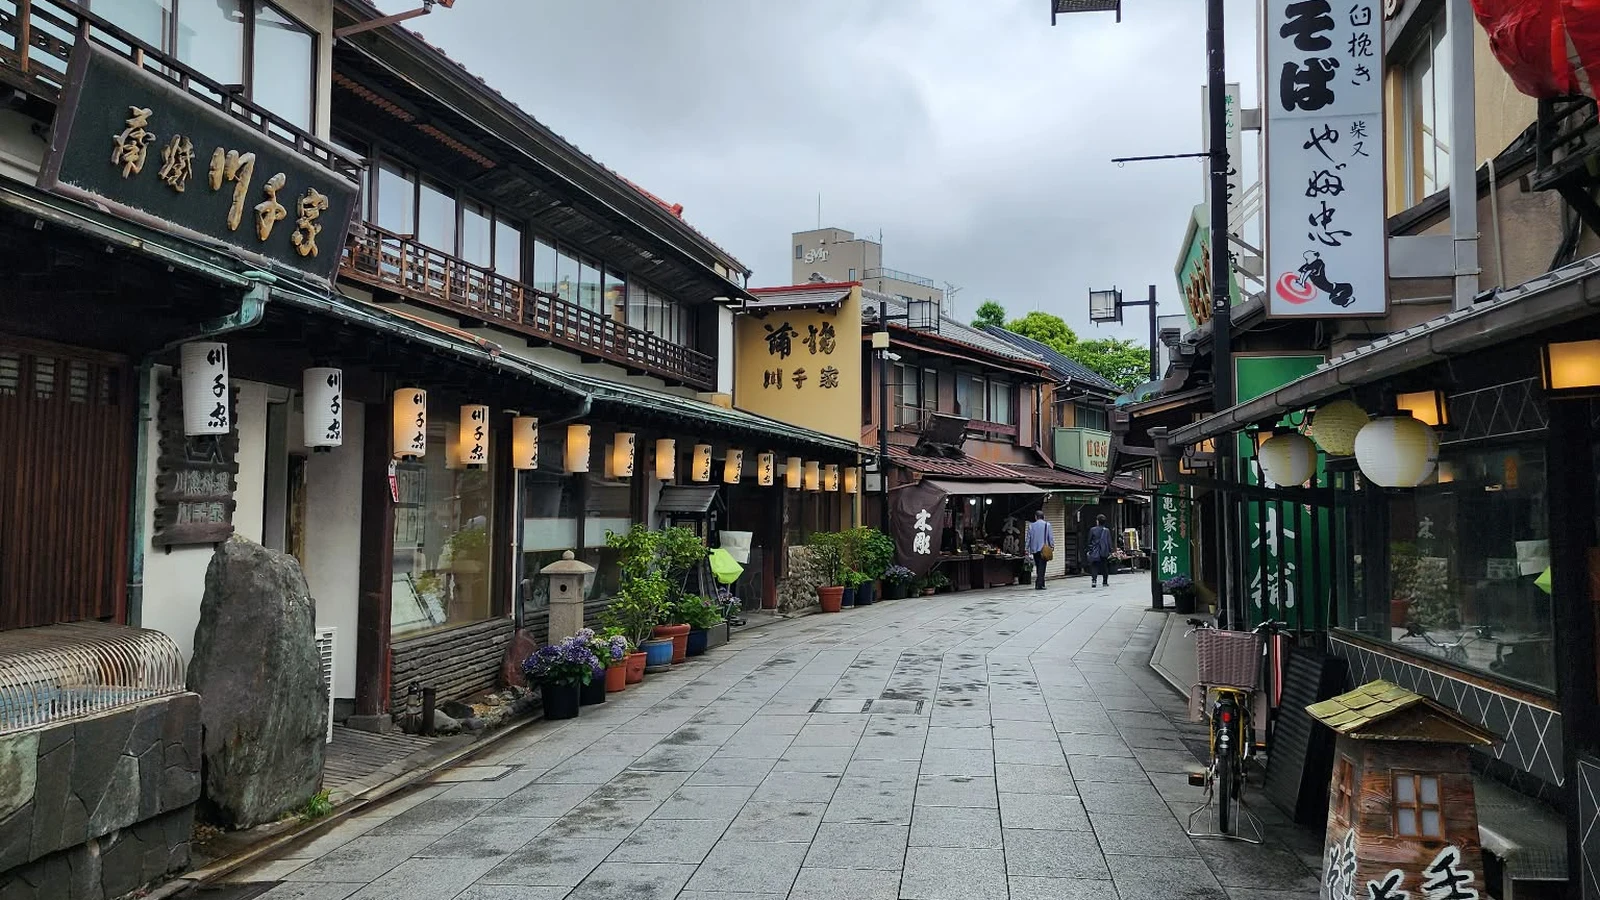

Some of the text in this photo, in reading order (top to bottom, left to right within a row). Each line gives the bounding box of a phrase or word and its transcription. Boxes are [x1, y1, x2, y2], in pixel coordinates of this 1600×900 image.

[1279, 0, 1340, 111] そば
[1348, 4, 1374, 86] 臼挽き
[1350, 120, 1369, 158] 柴又
[762, 366, 840, 390] 川千家
[913, 509, 933, 555] 木彫
